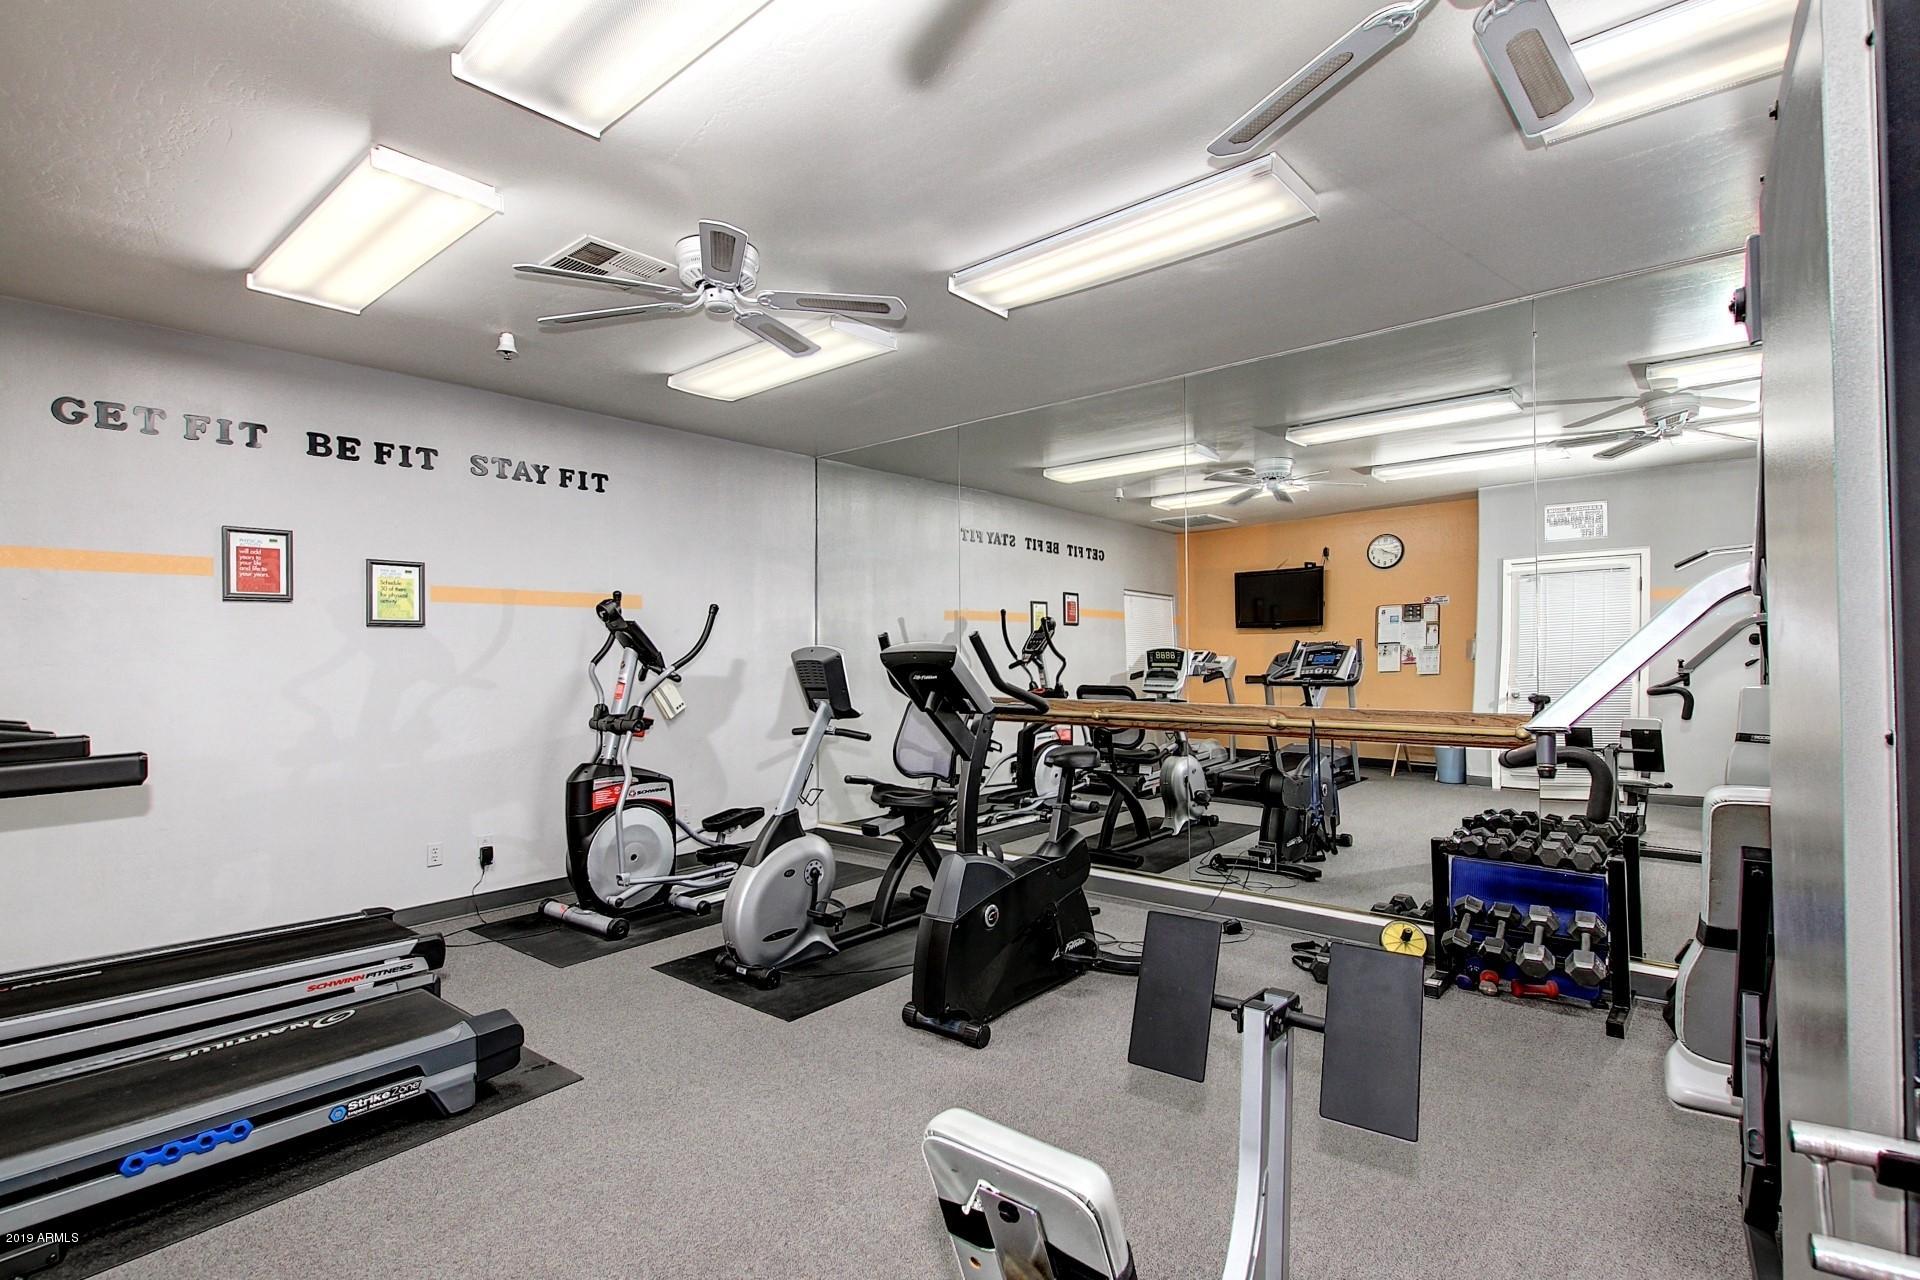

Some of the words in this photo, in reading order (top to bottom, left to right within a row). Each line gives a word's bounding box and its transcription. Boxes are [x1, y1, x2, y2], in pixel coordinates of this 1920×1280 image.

[50, 396, 167, 435] GET
[183, 414, 268, 449] FIT
[306, 432, 361, 461] BE
[373, 441, 438, 470] FIT
[470, 454, 550, 485] STAY
[558, 468, 609, 493] FIT
[637, 787, 667, 796] SCHWINN
[169, 1020, 310, 1062] NAUTILUS
